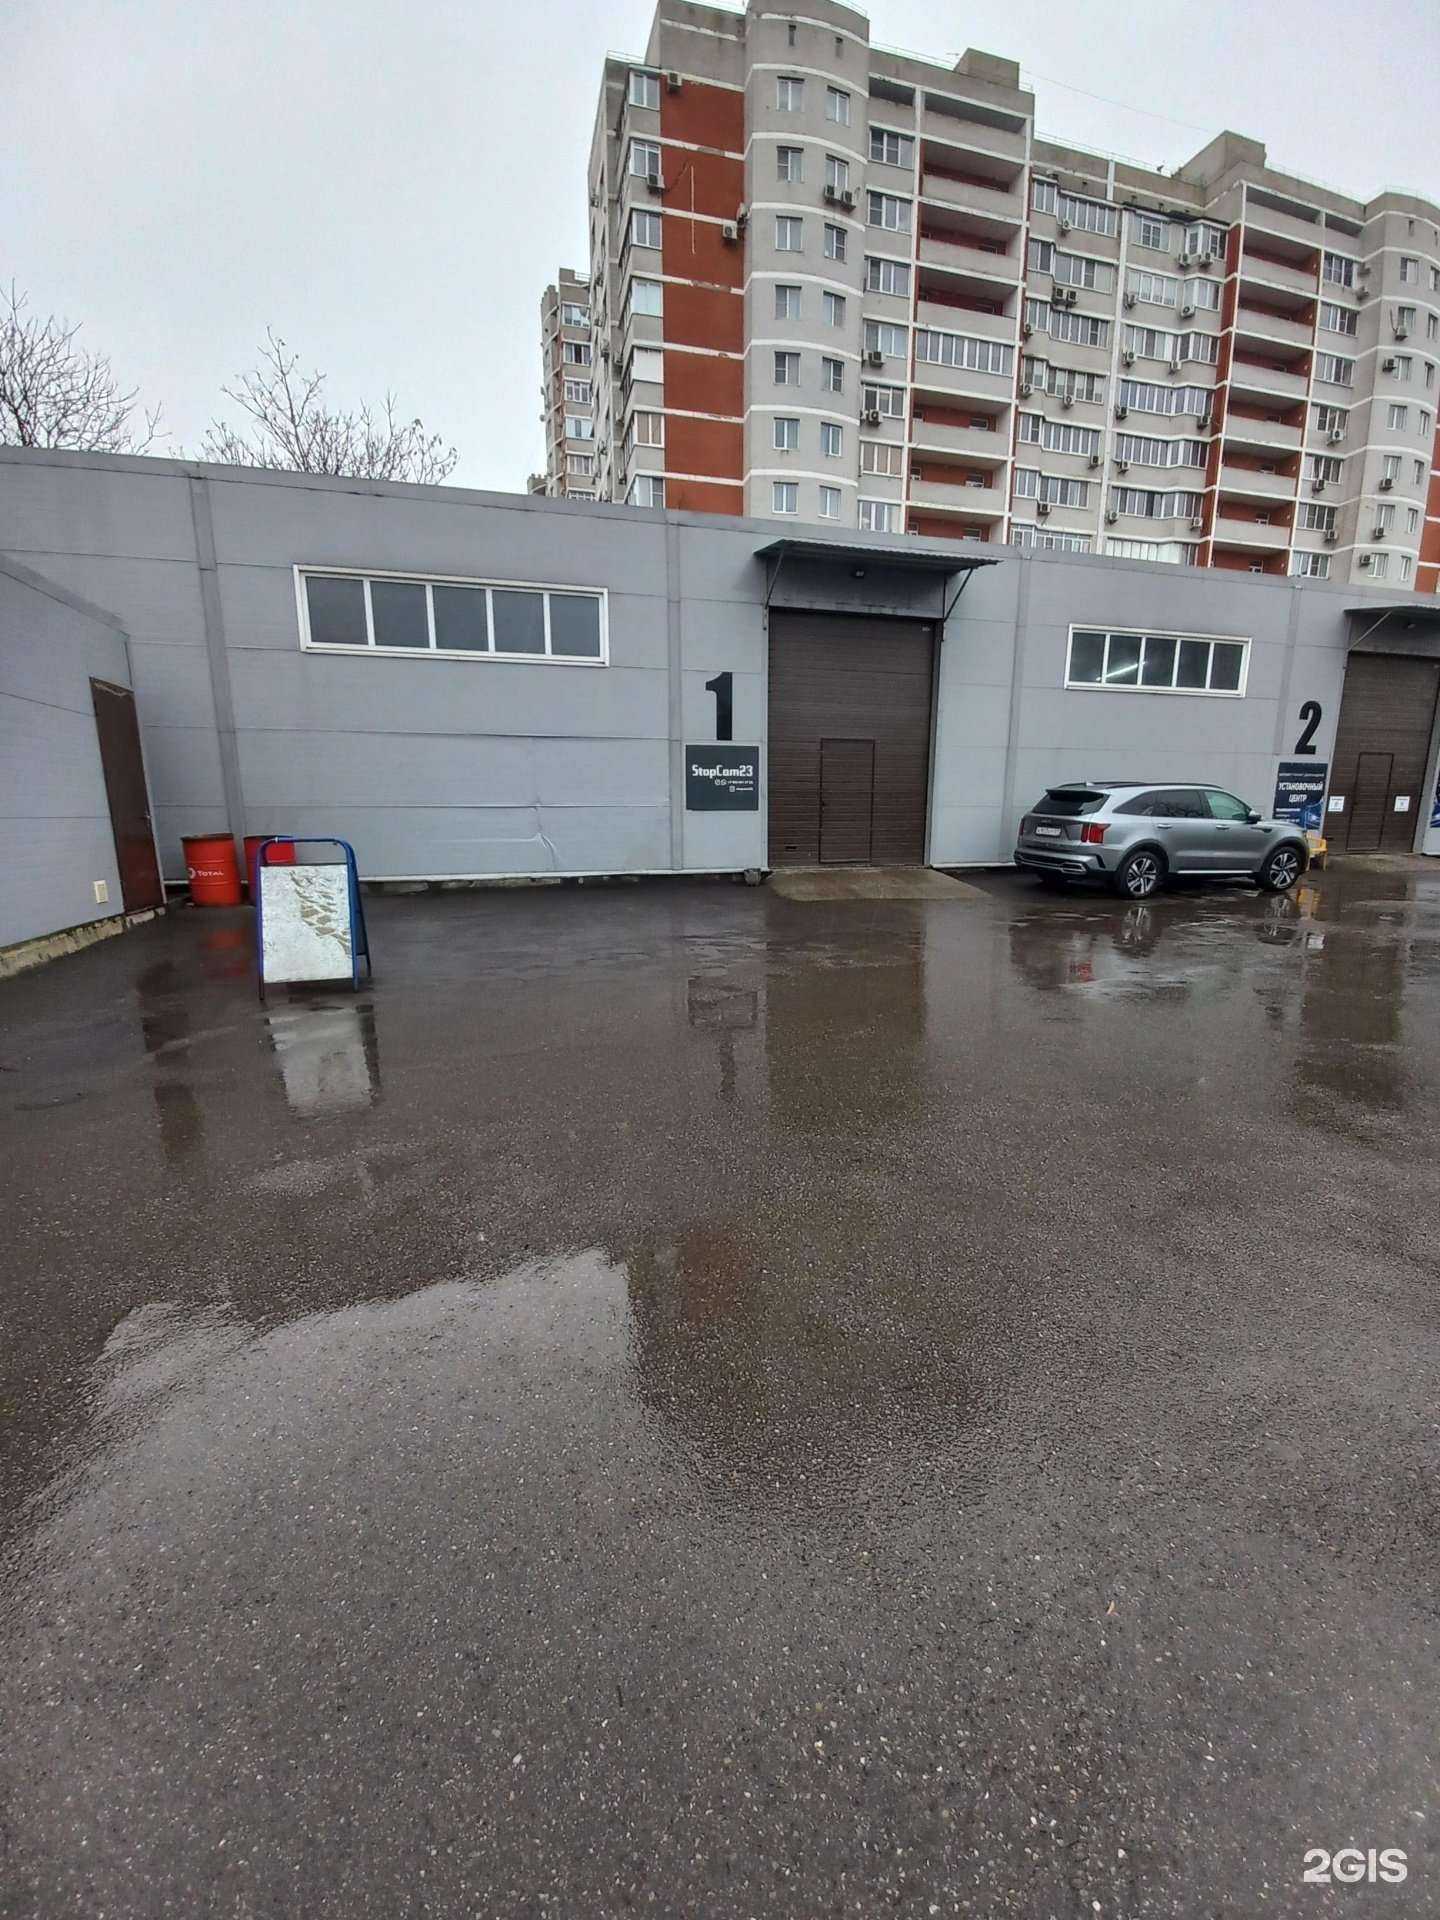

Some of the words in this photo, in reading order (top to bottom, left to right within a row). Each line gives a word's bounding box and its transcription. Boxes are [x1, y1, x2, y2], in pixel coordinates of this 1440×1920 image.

[705, 672, 733, 741] 1
[1294, 700, 1322, 755] 2
[691, 764, 753, 779] StopCam23
[1278, 781, 1323, 791] УСТАНОВОЧНЫЙ
[1289, 794, 1308, 803] ЦЕНТР
